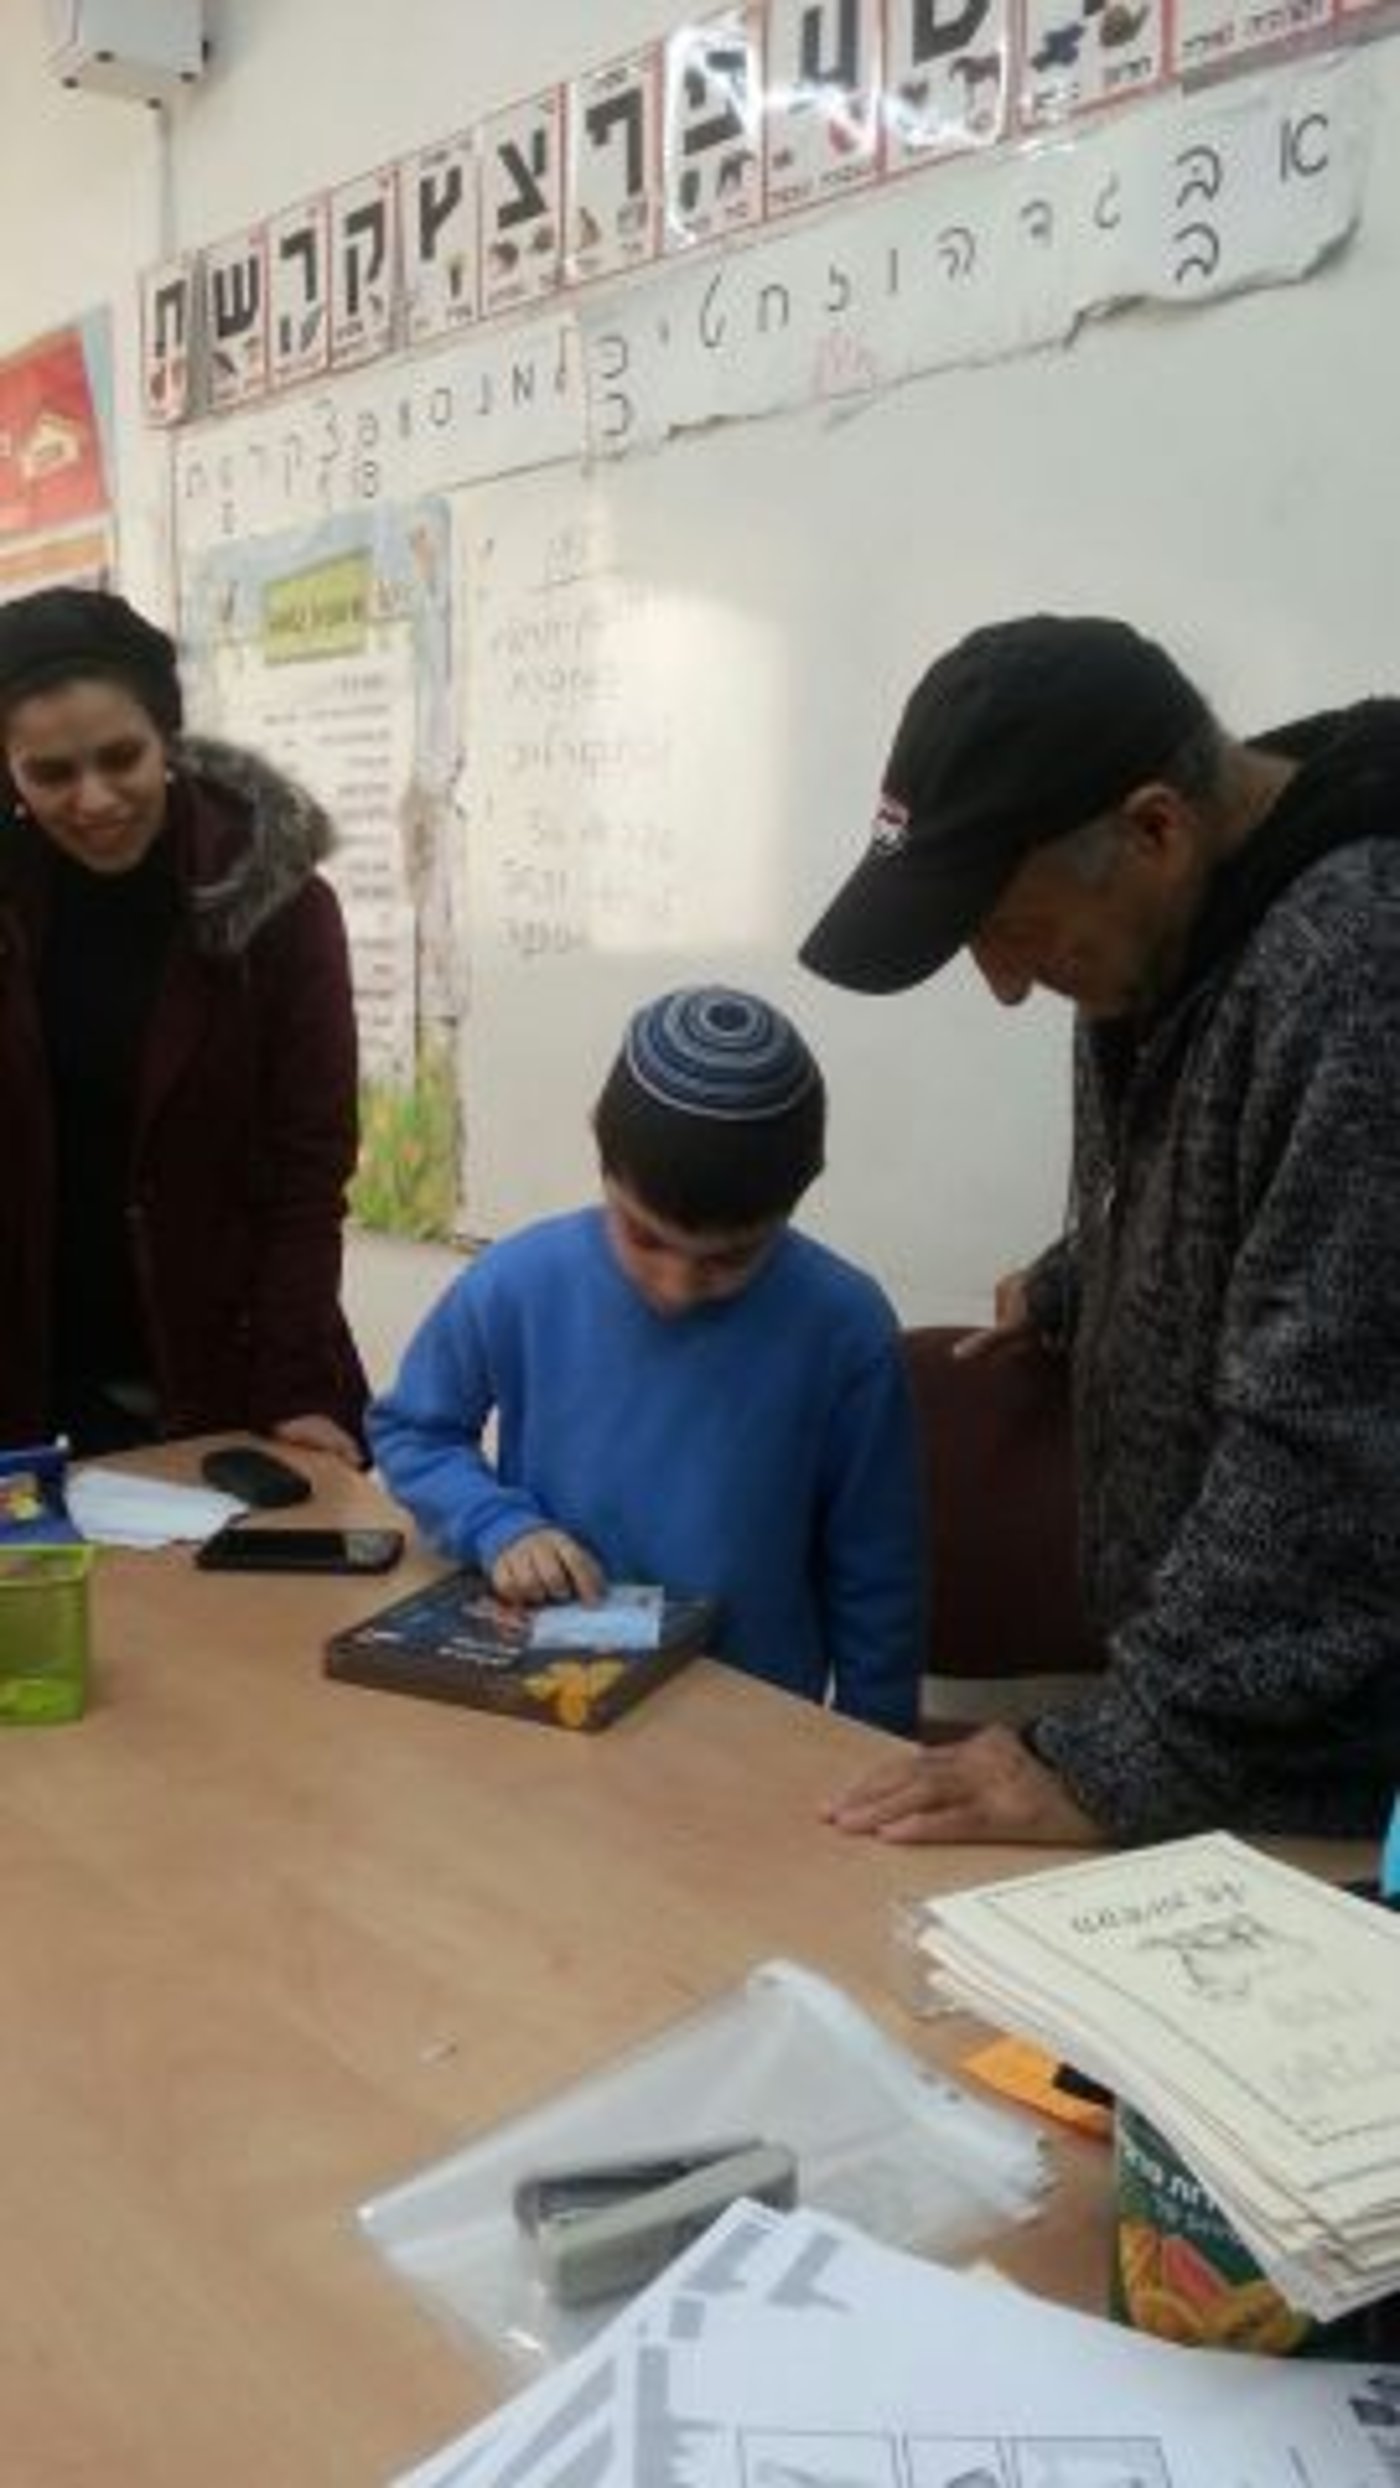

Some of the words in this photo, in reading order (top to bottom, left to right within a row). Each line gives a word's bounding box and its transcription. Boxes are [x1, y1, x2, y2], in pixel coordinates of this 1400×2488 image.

[497, 128, 547, 229] צ
[585, 87, 643, 198] ף
[345, 200, 385, 316] ק
[419, 165, 463, 261] ץ
[213, 255, 260, 339] ש
[279, 228, 318, 302] ר
[155, 279, 187, 358] ת
